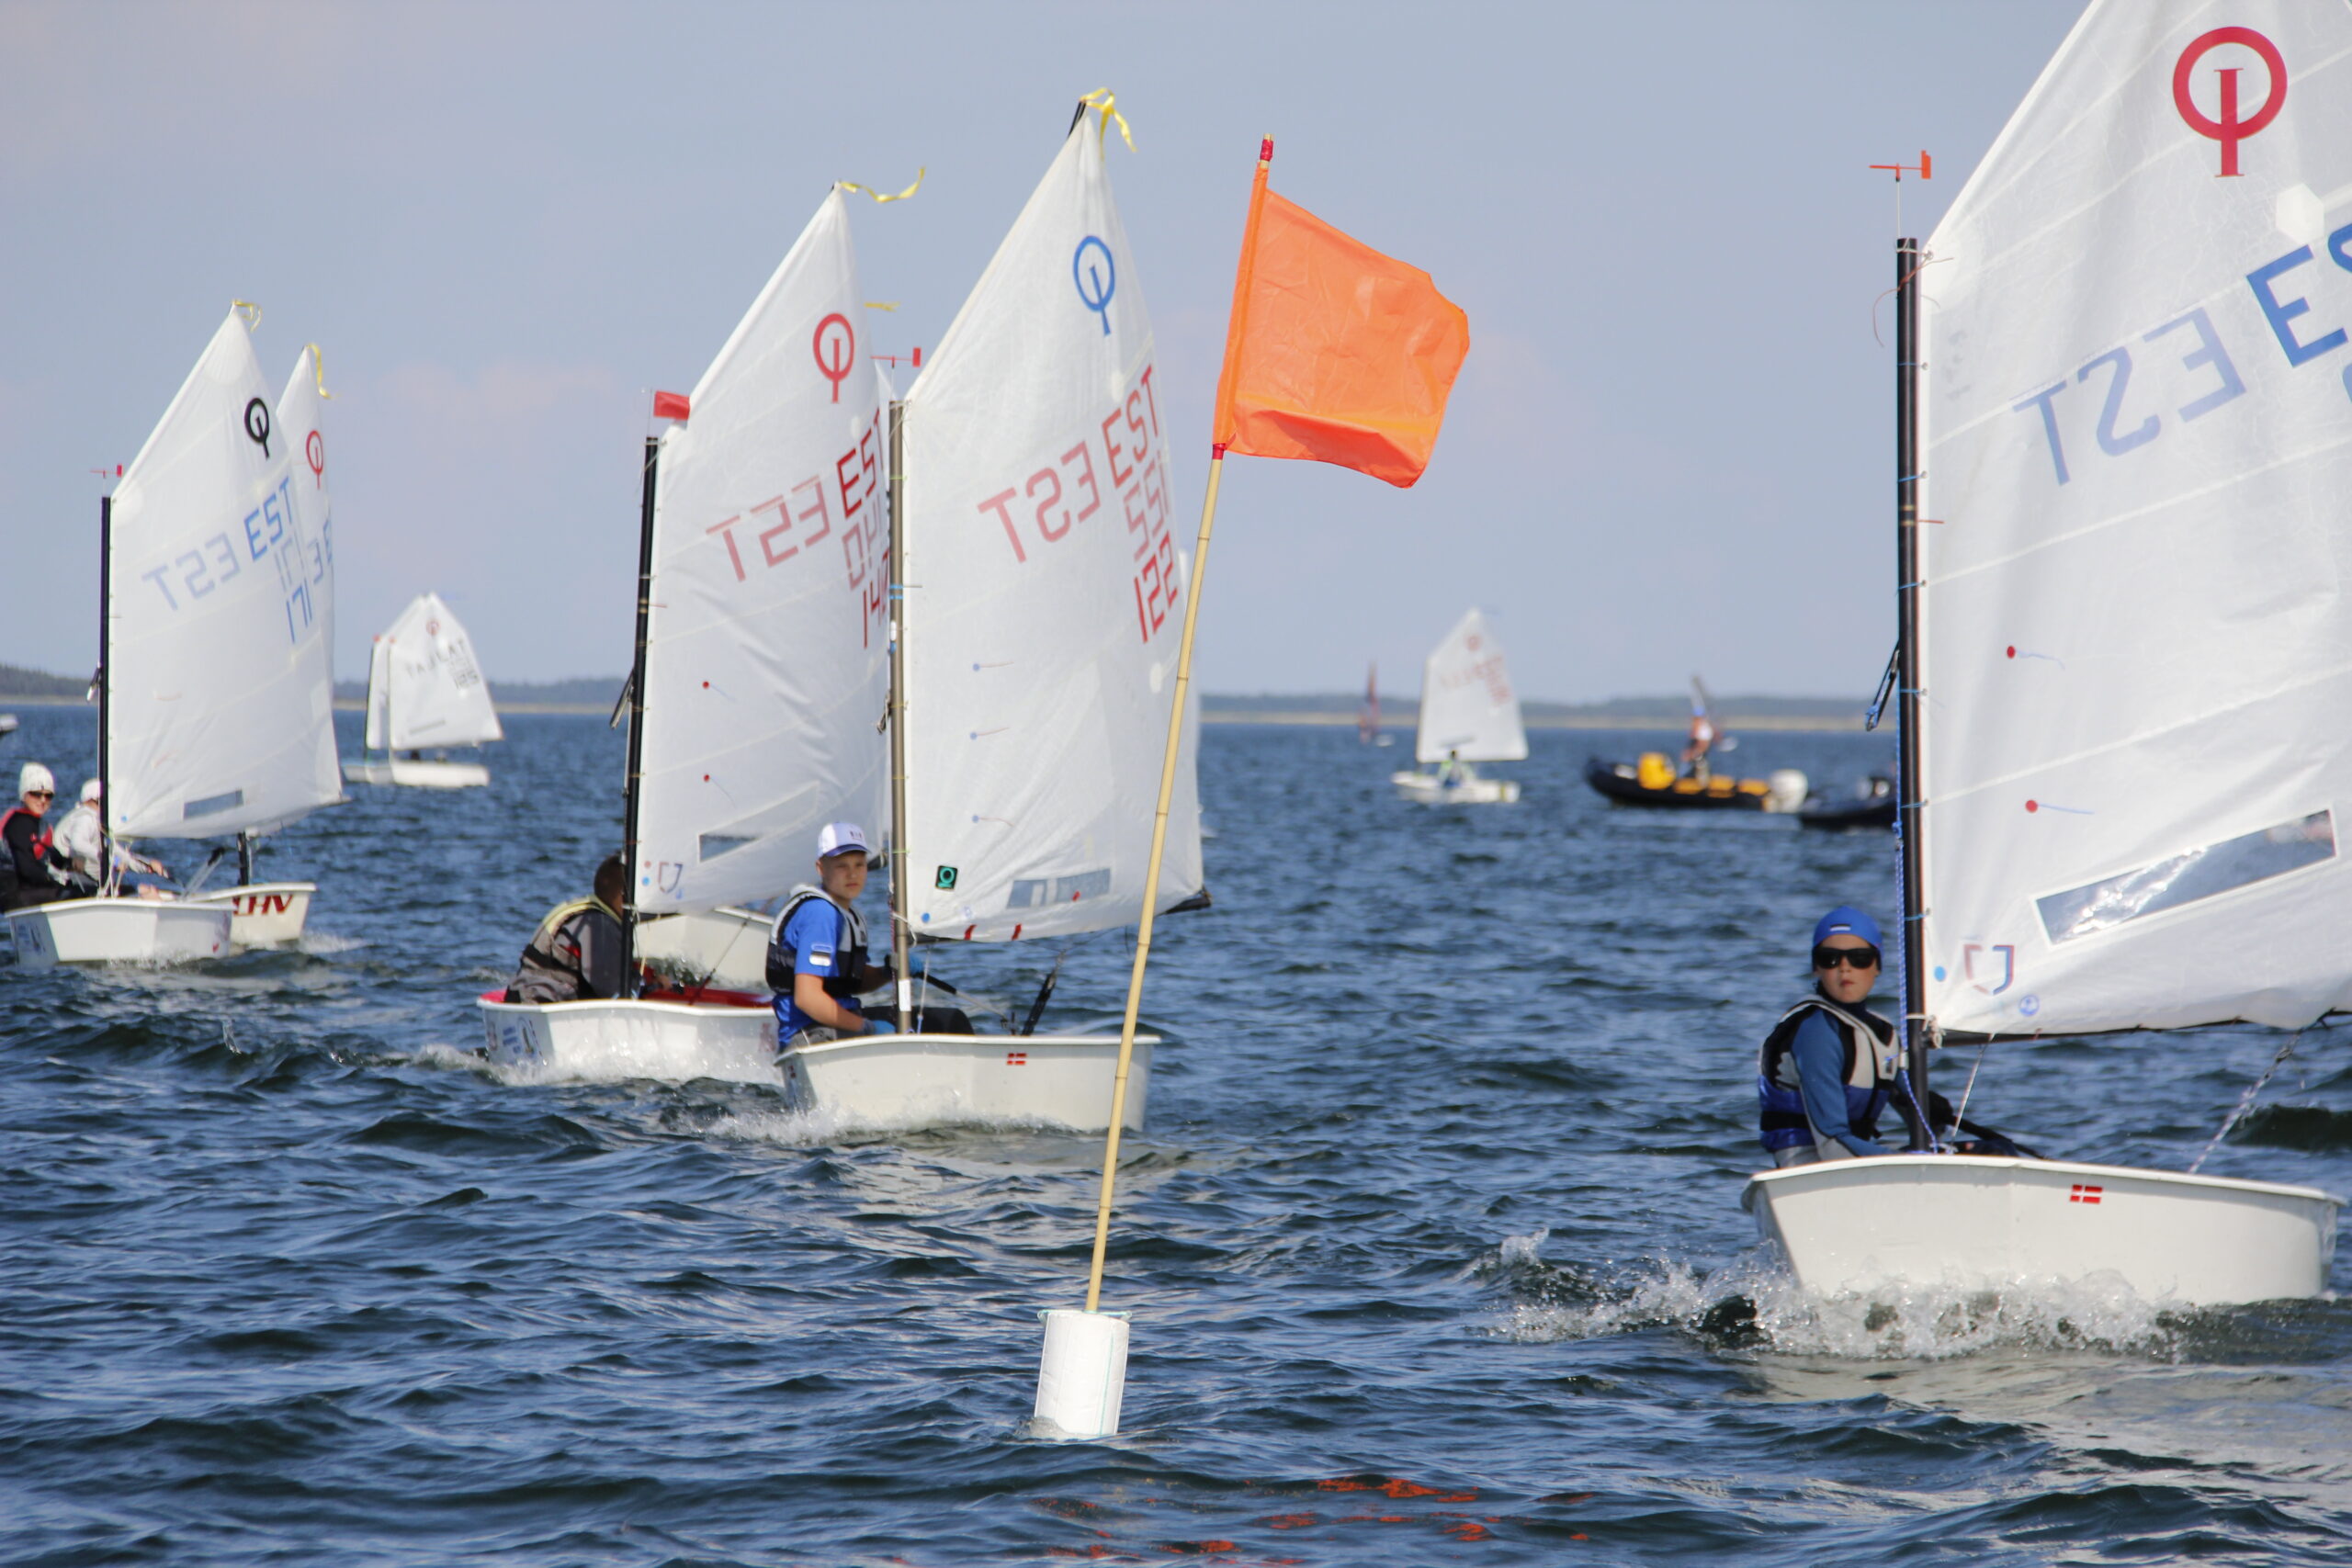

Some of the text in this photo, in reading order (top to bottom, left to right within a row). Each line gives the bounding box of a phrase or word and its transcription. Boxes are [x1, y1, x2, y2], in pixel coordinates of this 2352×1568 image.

[836, 409, 884, 519] EST
[1102, 365, 1159, 490] EST
[244, 476, 293, 562] EST
[1133, 530, 1178, 644] 122
